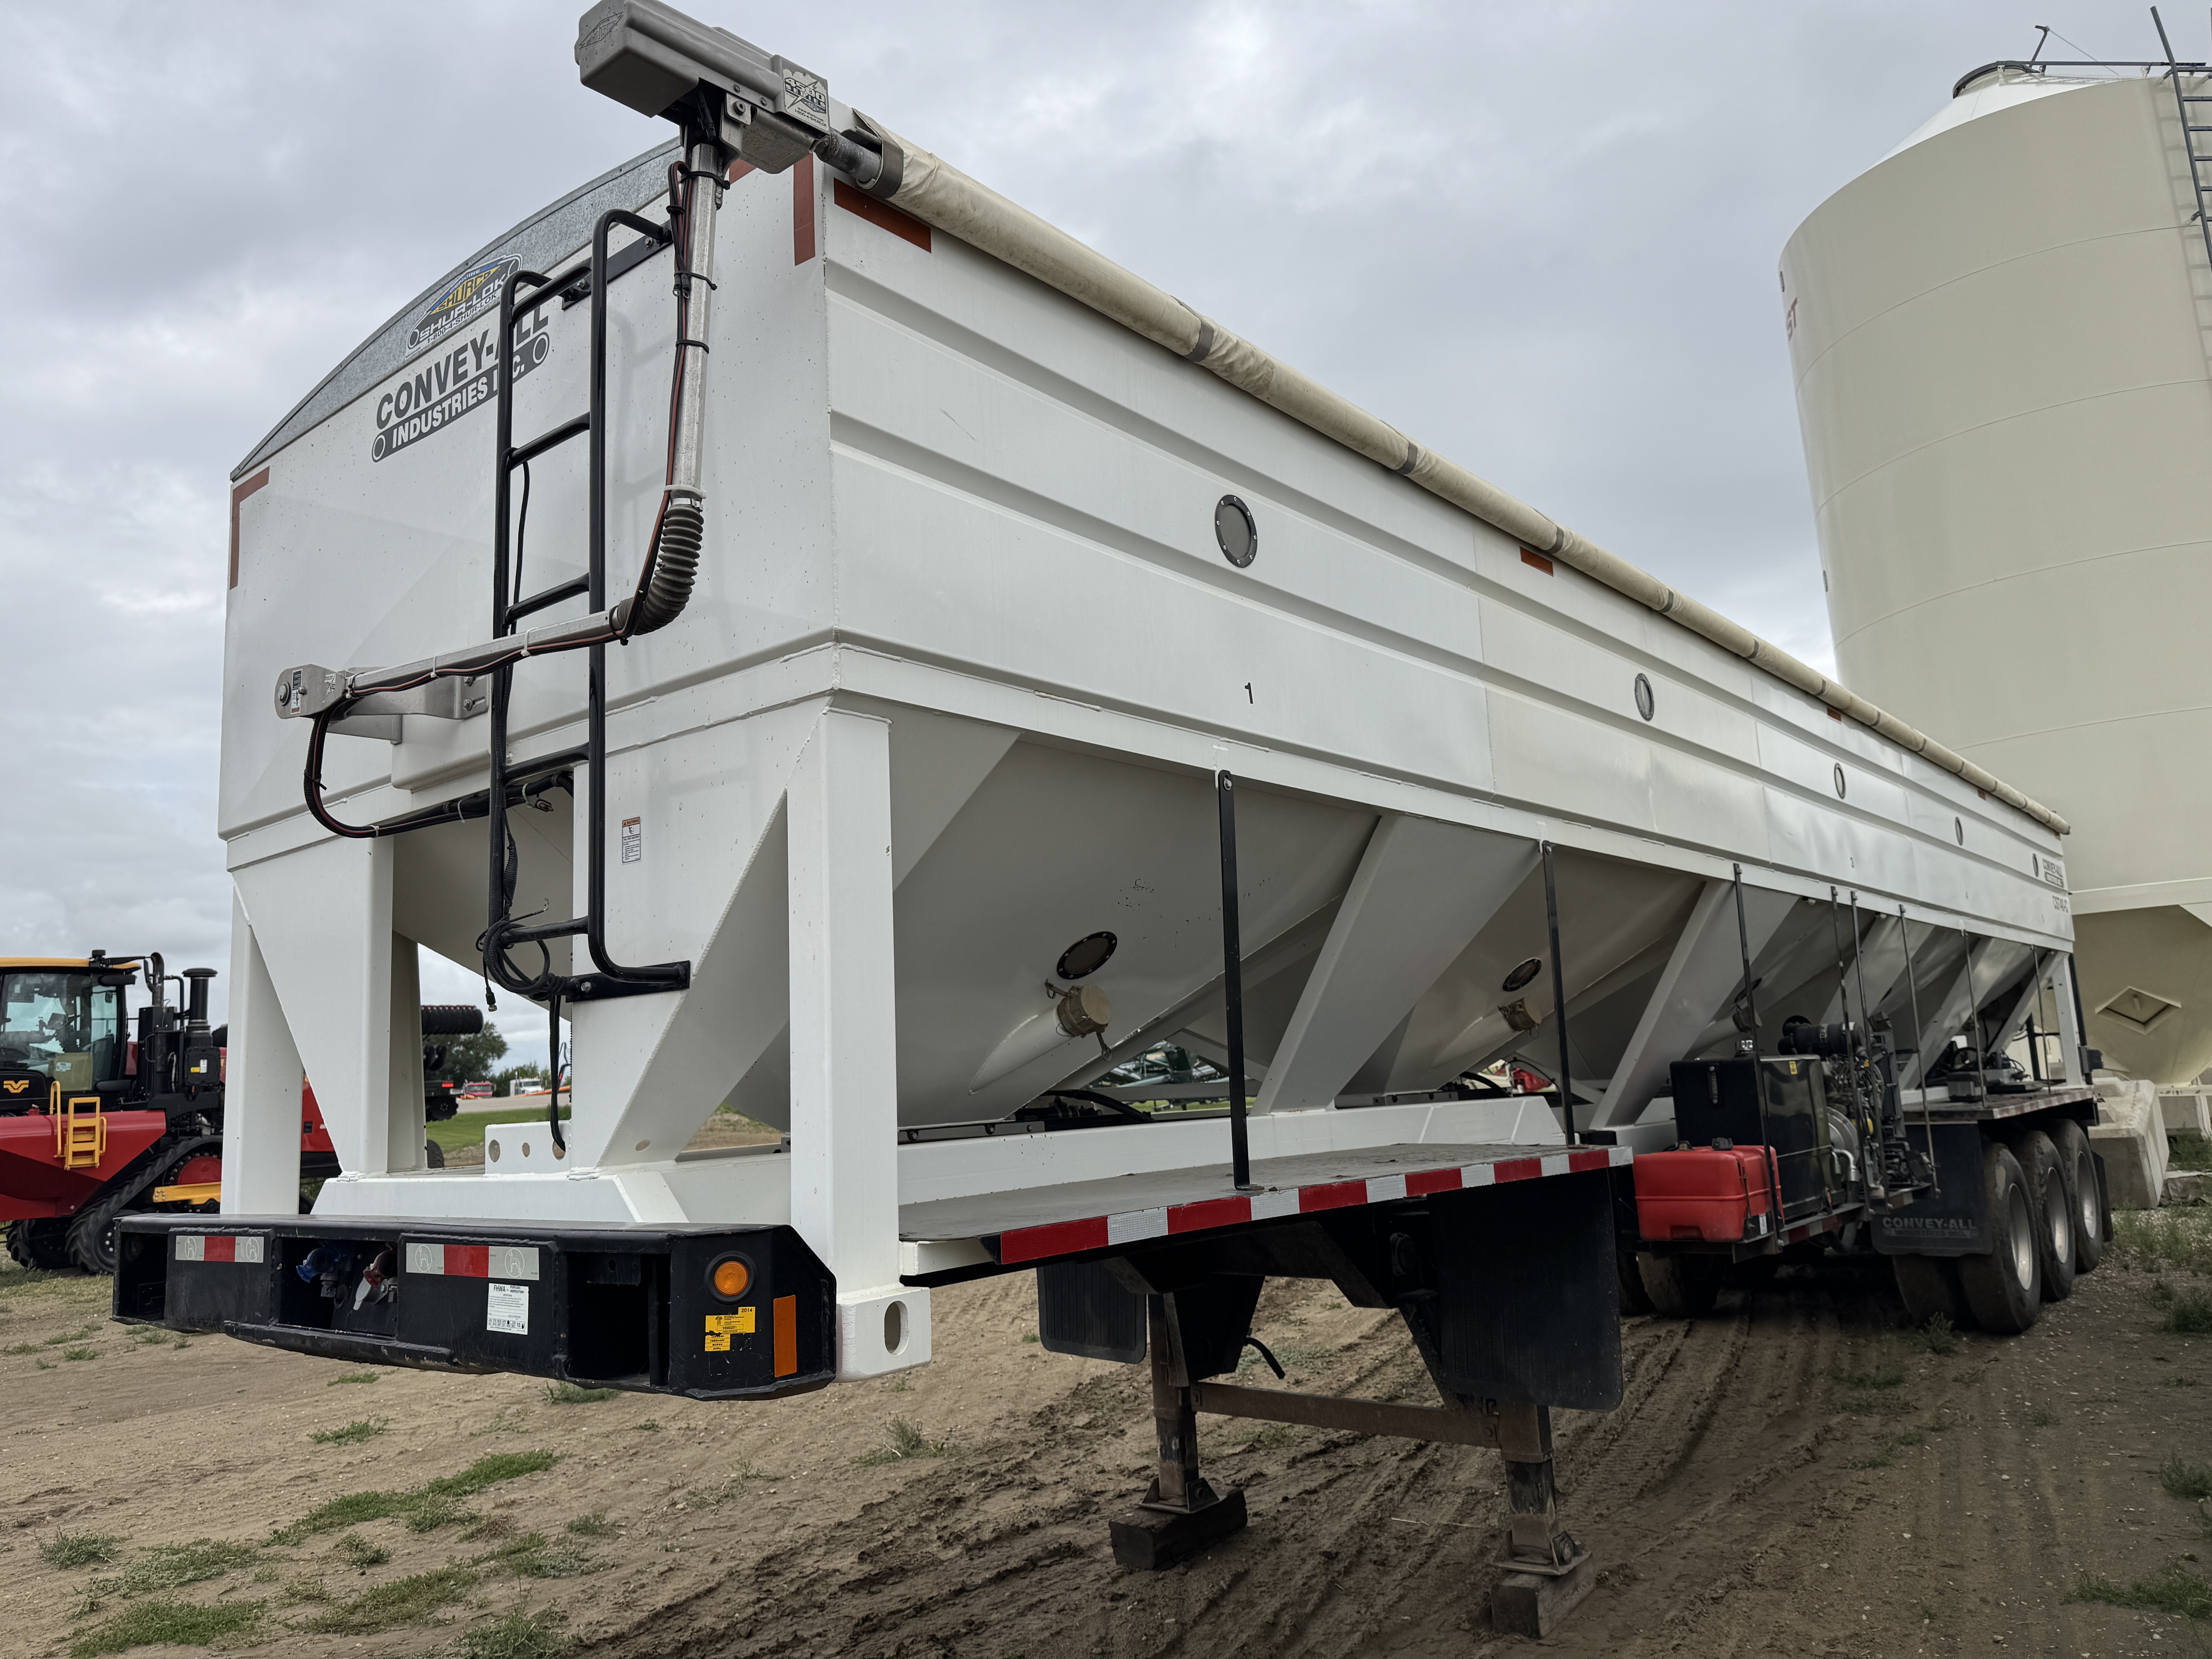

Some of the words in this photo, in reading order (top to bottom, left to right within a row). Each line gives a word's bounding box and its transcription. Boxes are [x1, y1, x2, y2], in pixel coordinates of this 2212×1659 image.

[785, 78, 825, 103] 4500
[786, 84, 826, 108] SERIES
[419, 273, 507, 342] SHUR-LOK
[427, 292, 496, 344] 1-800-4-SHUR-LOK
[392, 376, 488, 449] INDUSTRIES
[493, 354, 525, 392] IC.
[1244, 682, 1253, 704] 1
